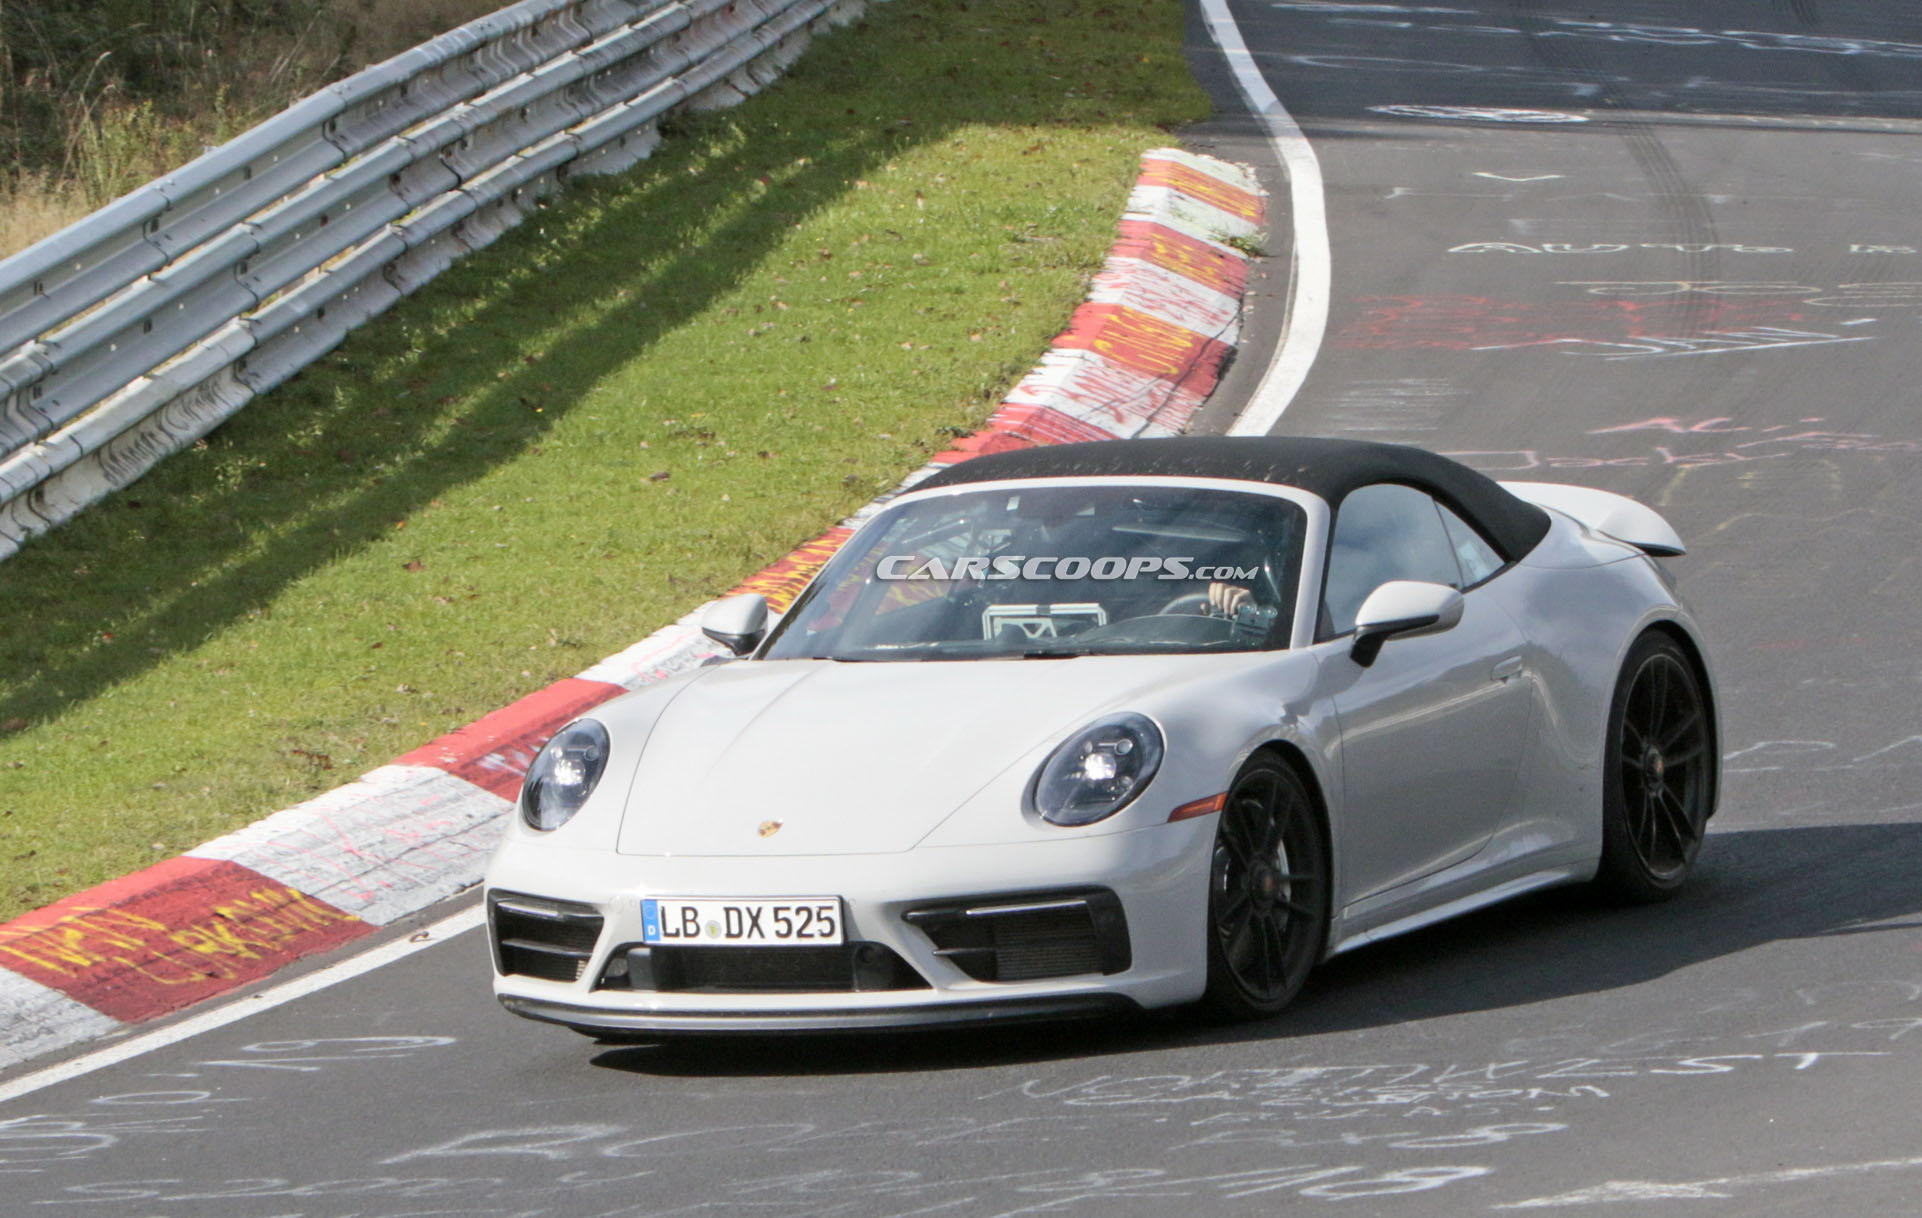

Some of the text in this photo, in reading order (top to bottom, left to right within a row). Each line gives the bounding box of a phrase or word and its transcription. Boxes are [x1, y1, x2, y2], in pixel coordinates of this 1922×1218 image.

[647, 926, 656, 936] D
[660, 906, 836, 938] LB DX 525
